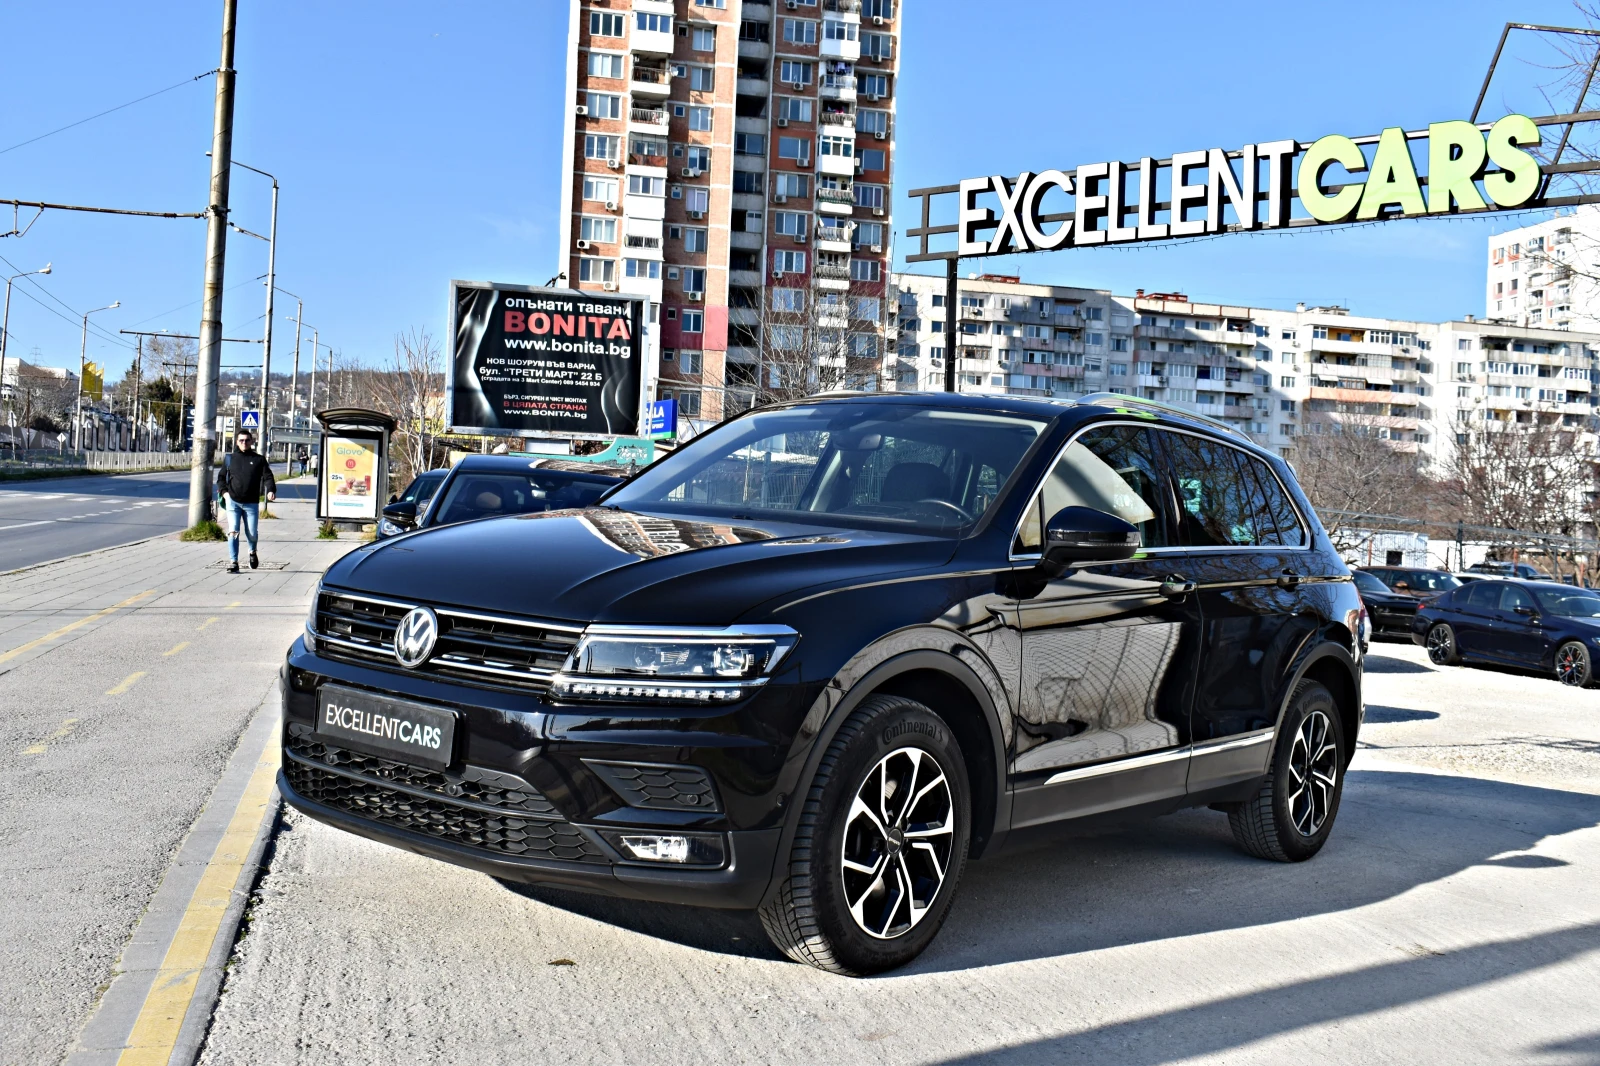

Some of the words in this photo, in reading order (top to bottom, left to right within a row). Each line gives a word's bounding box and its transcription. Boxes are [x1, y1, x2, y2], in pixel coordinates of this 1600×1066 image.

[504, 310, 631, 341] BONITA
[504, 337, 631, 359] www.bonita.bg
[486, 357, 506, 365] НОВ
[507, 359, 545, 367] ШОУРУМ
[546, 360, 565, 368] ВЪВ
[567, 362, 596, 371] ВАРНА
[479, 366, 501, 376] бул.
[580, 372, 592, 380] 22
[595, 373, 603, 381] Б
[512, 401, 548, 409] ЦЯЛАТА
[549, 403, 588, 411] СТРАНА!
[504, 408, 588, 420] www.BONITA.bg
[336, 447, 363, 456] Glovo
[881, 717, 938, 746] Continental
